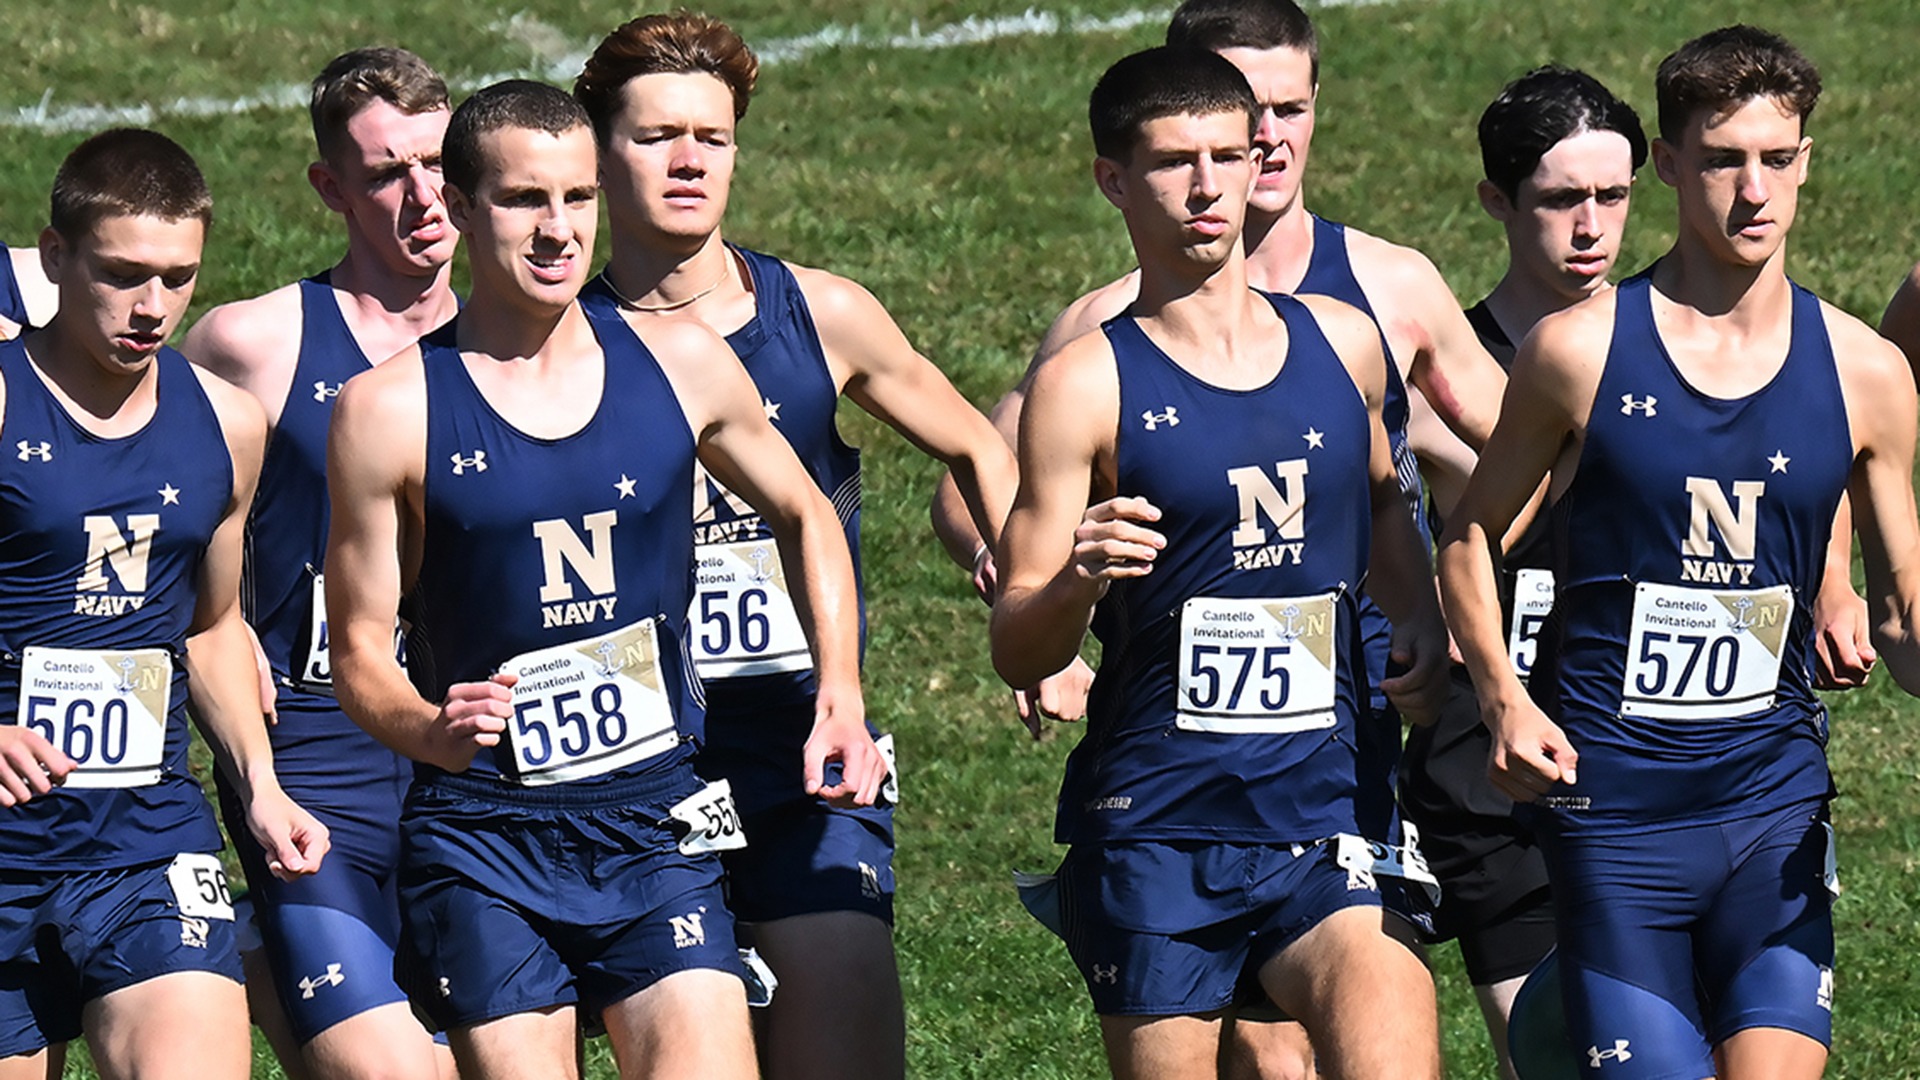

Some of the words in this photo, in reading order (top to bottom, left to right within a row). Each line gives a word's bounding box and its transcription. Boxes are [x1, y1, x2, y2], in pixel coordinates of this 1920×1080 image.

[1227, 458, 1309, 547] N
[1681, 476, 1765, 560] N
[76, 514, 160, 592] N
[533, 509, 618, 603] N
[1232, 543, 1304, 570] NAVY
[1681, 558, 1755, 585] NAVY
[73, 595, 146, 617] NAVY
[541, 596, 618, 628] NAVY
[1202, 610, 1255, 623] Cantello
[1655, 597, 1707, 612] Cantello
[1758, 604, 1780, 628] N
[685, 588, 770, 655] 56
[1193, 627, 1265, 640] Invitational
[1306, 612, 1327, 637] N
[1645, 613, 1716, 629] Invitational
[43, 660, 95, 674] Cantello
[519, 657, 571, 678] Cantello
[624, 640, 644, 668] N
[1635, 630, 1740, 697] 570
[34, 677, 104, 692] Invitational
[140, 667, 160, 692] N
[514, 671, 585, 696] Invitational
[1189, 644, 1291, 710] 575
[27, 695, 129, 765] 560
[514, 682, 628, 766] 558
[668, 912, 705, 940] N
